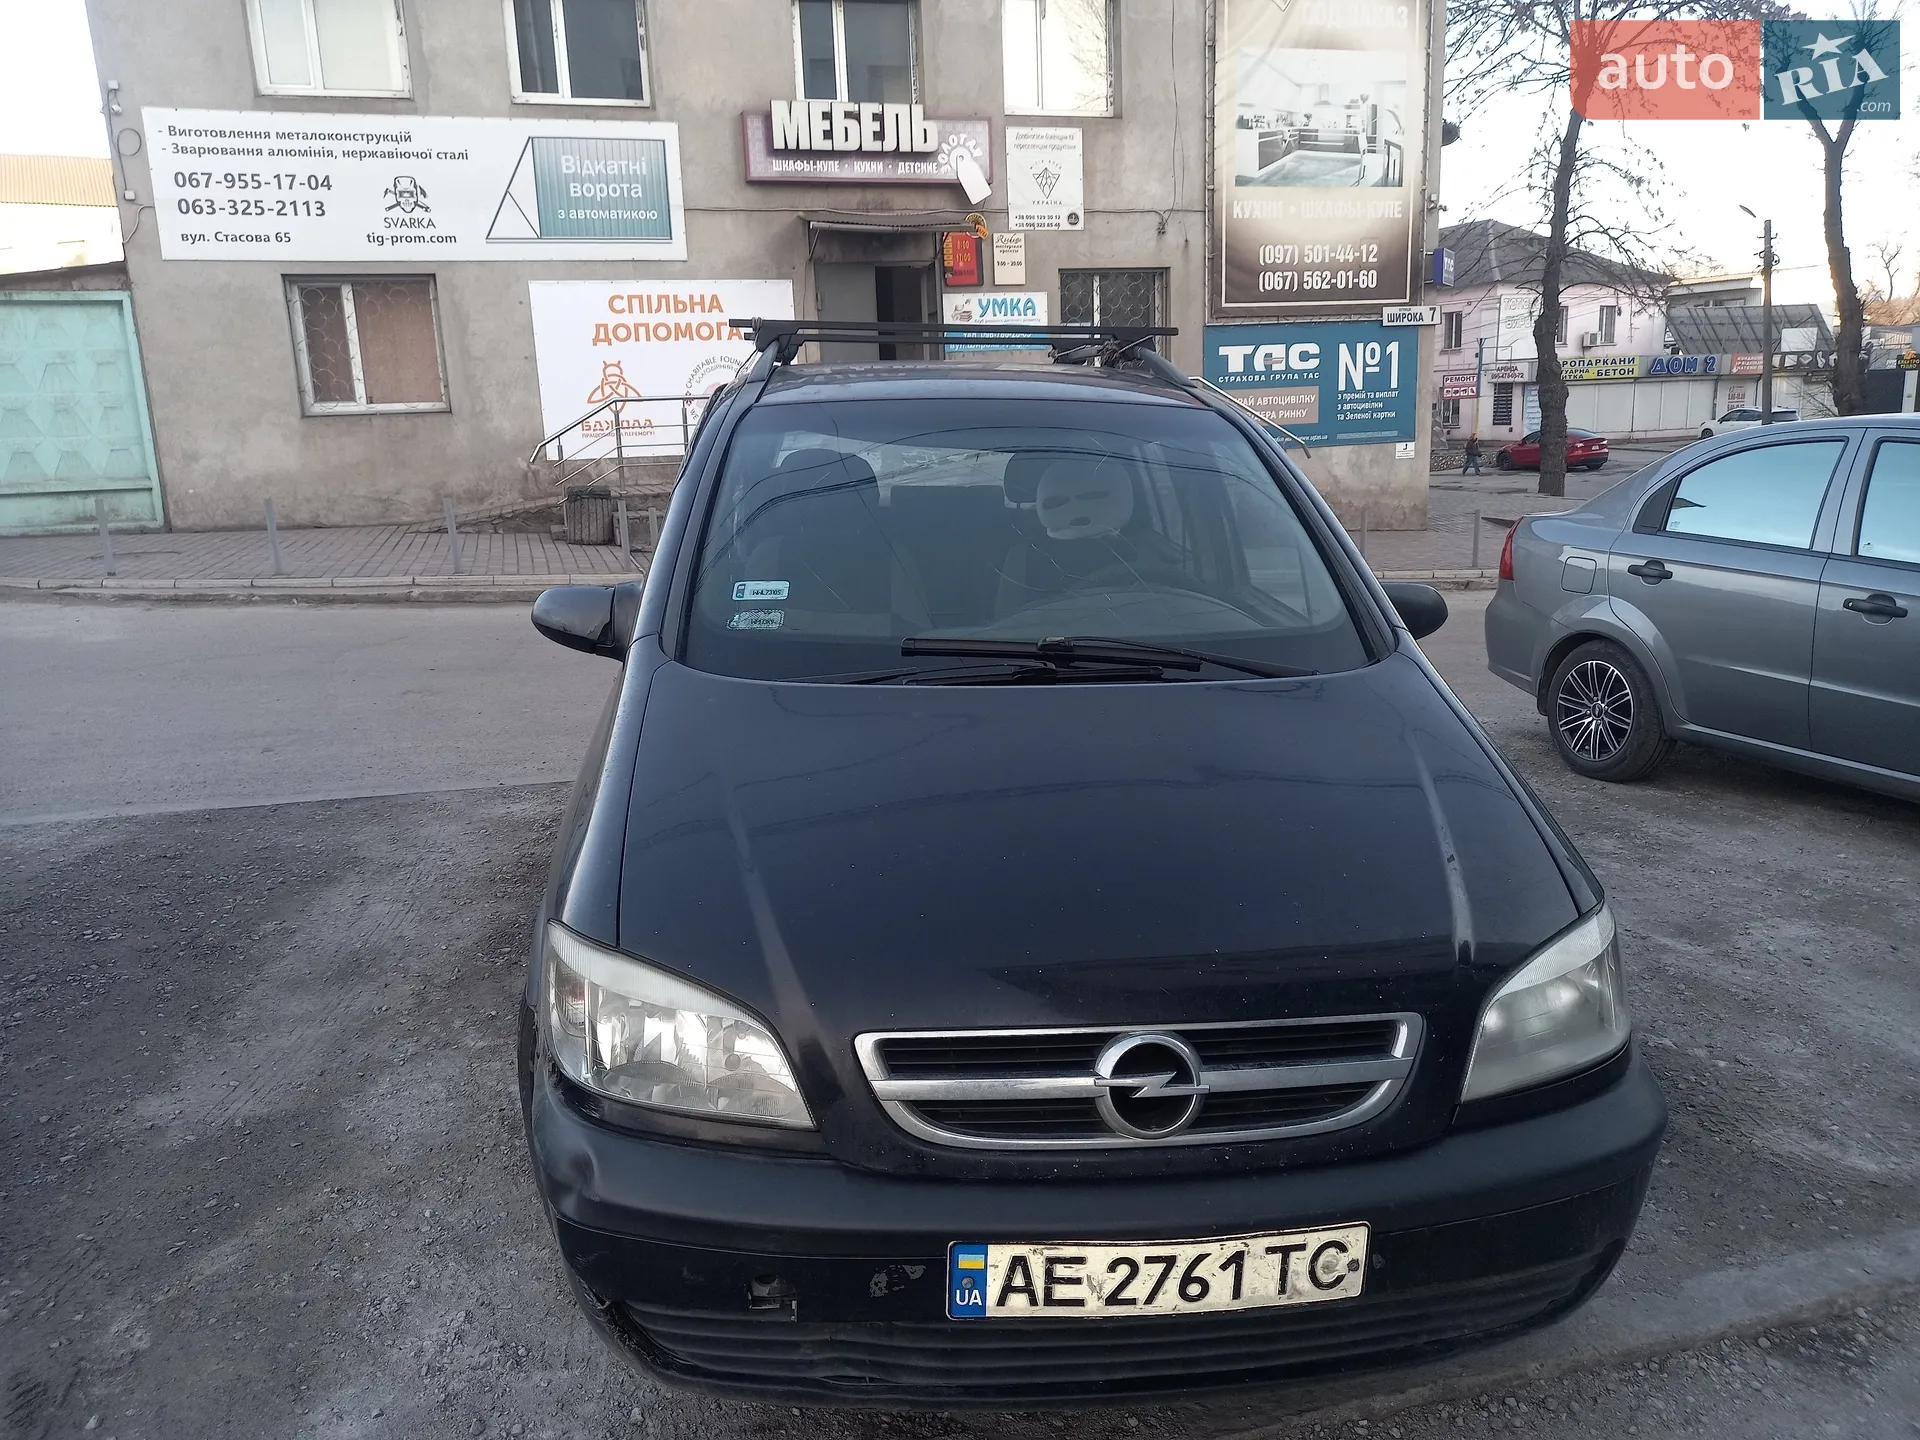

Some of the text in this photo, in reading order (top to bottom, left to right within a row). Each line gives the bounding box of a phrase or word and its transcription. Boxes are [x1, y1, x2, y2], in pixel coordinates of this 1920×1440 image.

[168, 125, 412, 144] Виготовлення металоконструкцій
[770, 100, 938, 153] МЕБЕЛЬ
[171, 143, 469, 161] Зварювання алюмінія, нержавіючої сталі
[560, 154, 647, 176] Відкатні
[772, 159, 938, 175] ШКАФЫ-КУПЕ КУХНИ ДЕТСКИЕ
[174, 171, 332, 192] 067-955-17-04
[569, 182, 643, 202] ворота
[177, 198, 326, 217] 063-325-2113
[558, 208, 658, 220] з автоматикою
[1233, 200, 1402, 218] КУХНИ ШКАФЫ-КУПЕ
[384, 217, 436, 230] SVARKA
[181, 231, 291, 244] вул. Стасова 65
[366, 232, 457, 246] tig-prom.com
[1259, 244, 1378, 265] (097) 501-44-12
[1258, 270, 1377, 292] (067) 562-01-60
[608, 293, 724, 314] СПІЛЬНА
[977, 297, 1036, 318] УМКА
[1387, 307, 1436, 323] ШИРОКА 7
[592, 321, 743, 346] ДОПОМОГА
[1562, 357, 1635, 368] РОПАРКАНИ
[1651, 355, 1699, 375] ДОМ
[1706, 355, 1717, 373] 2
[1218, 375, 1265, 383] СТРАХОВА
[1270, 373, 1299, 381] ГРУПА
[1445, 375, 1476, 383] РЕМОНТ
[1596, 368, 1635, 377] БЕТОН
[1257, 394, 1316, 406] АВТОЦИВІЛКУ
[1375, 390, 1399, 399] виплат
[1279, 409, 1308, 419] РИНКУ
[1343, 401, 1383, 411] автоцивілки
[1345, 411, 1371, 420] Зеленої
[1373, 411, 1396, 420] картки
[956, 1239, 1349, 1308] UA AE 2761 TC
